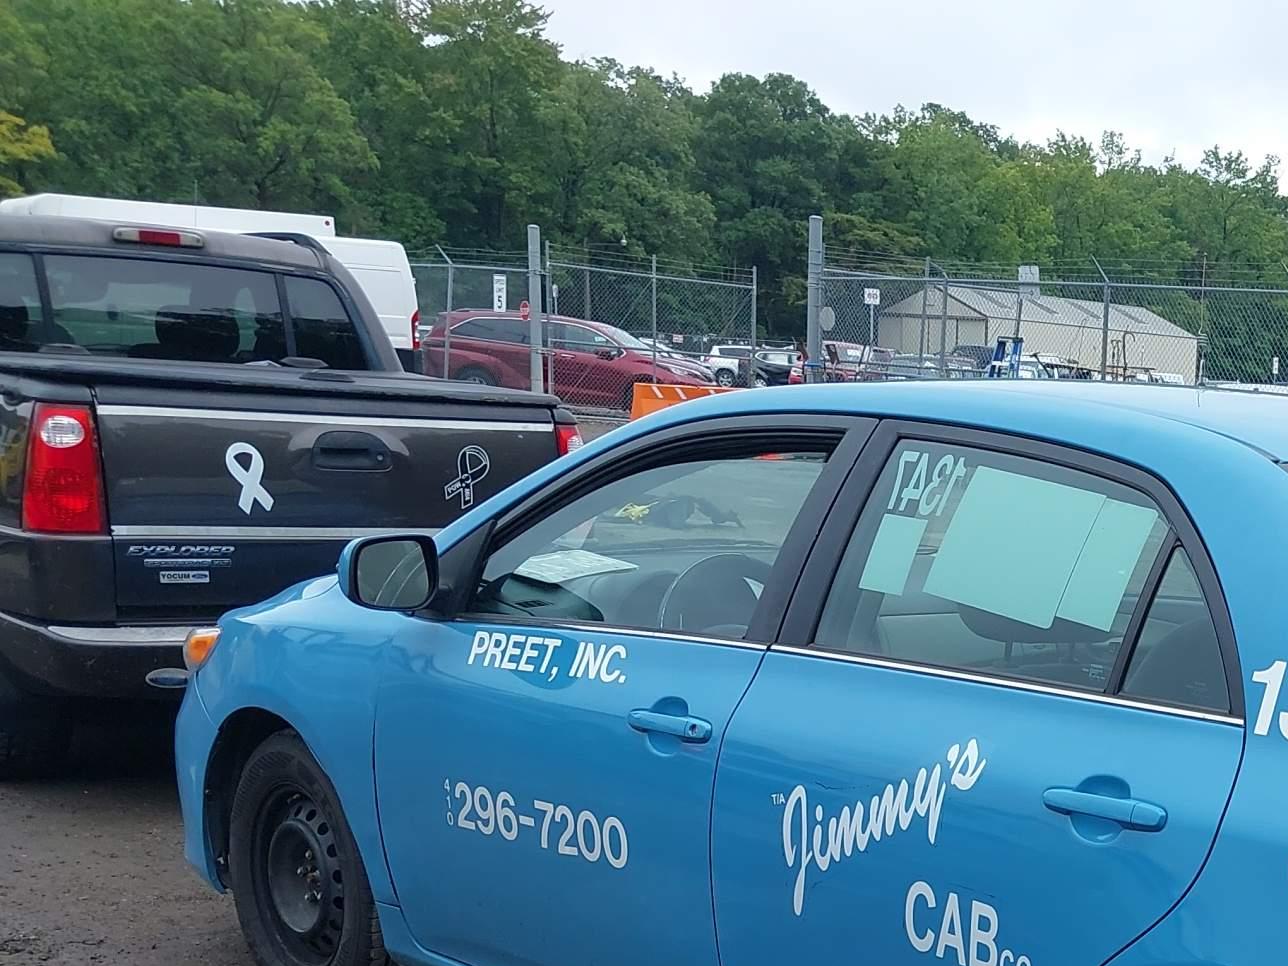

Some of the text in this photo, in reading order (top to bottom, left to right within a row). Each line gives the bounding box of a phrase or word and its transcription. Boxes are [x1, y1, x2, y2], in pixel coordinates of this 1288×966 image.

[497, 295, 503, 309] 5
[128, 546, 235, 556] EXPLORER
[467, 630, 628, 684] PREET, INC.
[454, 782, 629, 869] 296-7200
[782, 738, 987, 917] Jimmy's
